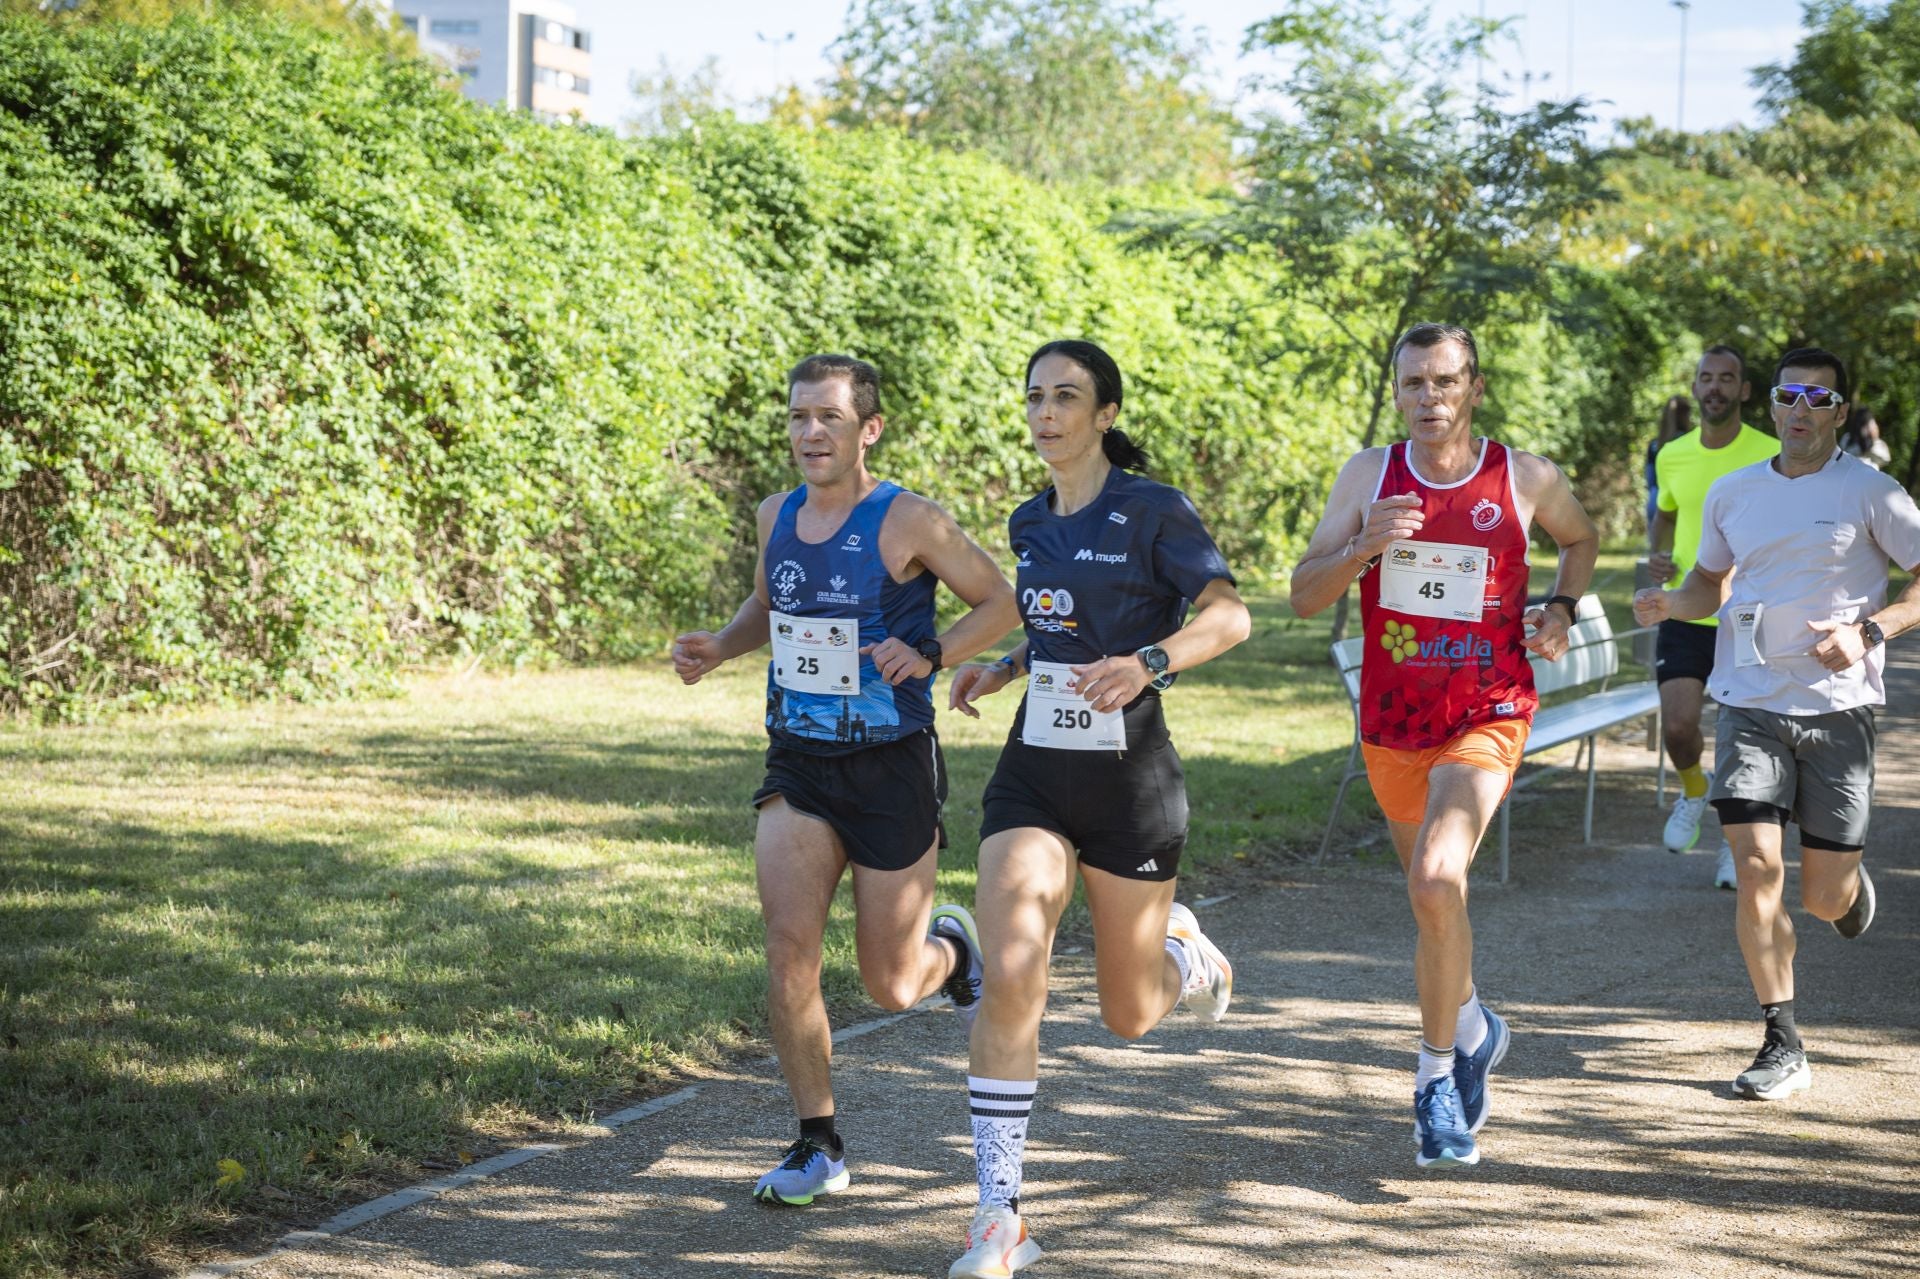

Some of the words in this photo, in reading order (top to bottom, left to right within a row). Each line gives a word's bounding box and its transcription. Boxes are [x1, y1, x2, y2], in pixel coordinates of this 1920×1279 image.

[1095, 552, 1128, 565] mupol
[1418, 581, 1446, 600] 45
[1022, 588, 1074, 616] 200
[1420, 633, 1492, 659] vitalia
[797, 656, 820, 675] 25
[1053, 708, 1092, 729] 250
